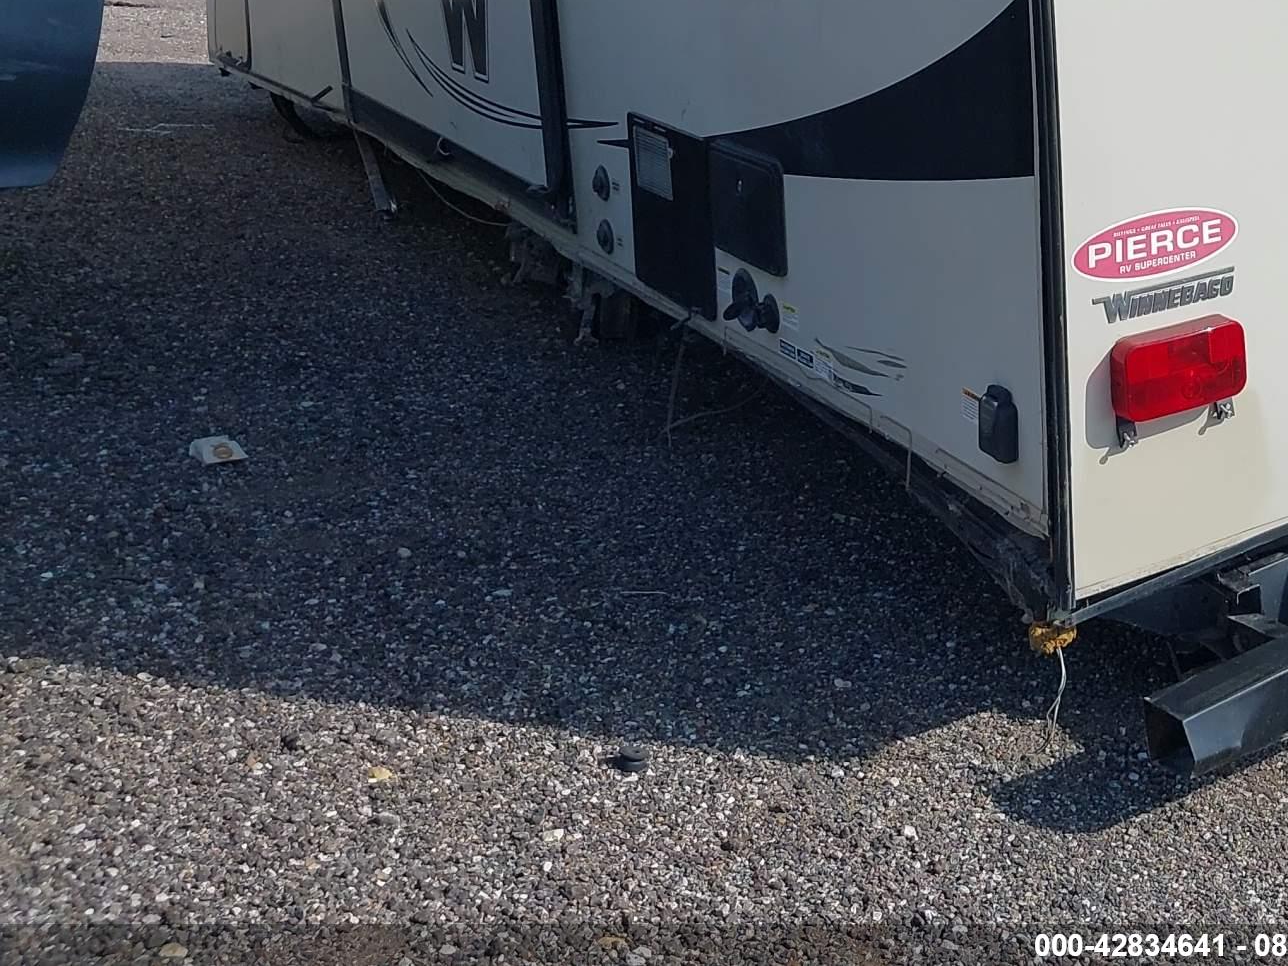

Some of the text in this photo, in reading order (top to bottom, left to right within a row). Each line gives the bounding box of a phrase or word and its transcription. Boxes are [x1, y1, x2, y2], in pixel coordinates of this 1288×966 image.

[1088, 218, 1222, 269] PIERCE
[1119, 250, 1197, 275] RV SUPERCENTER
